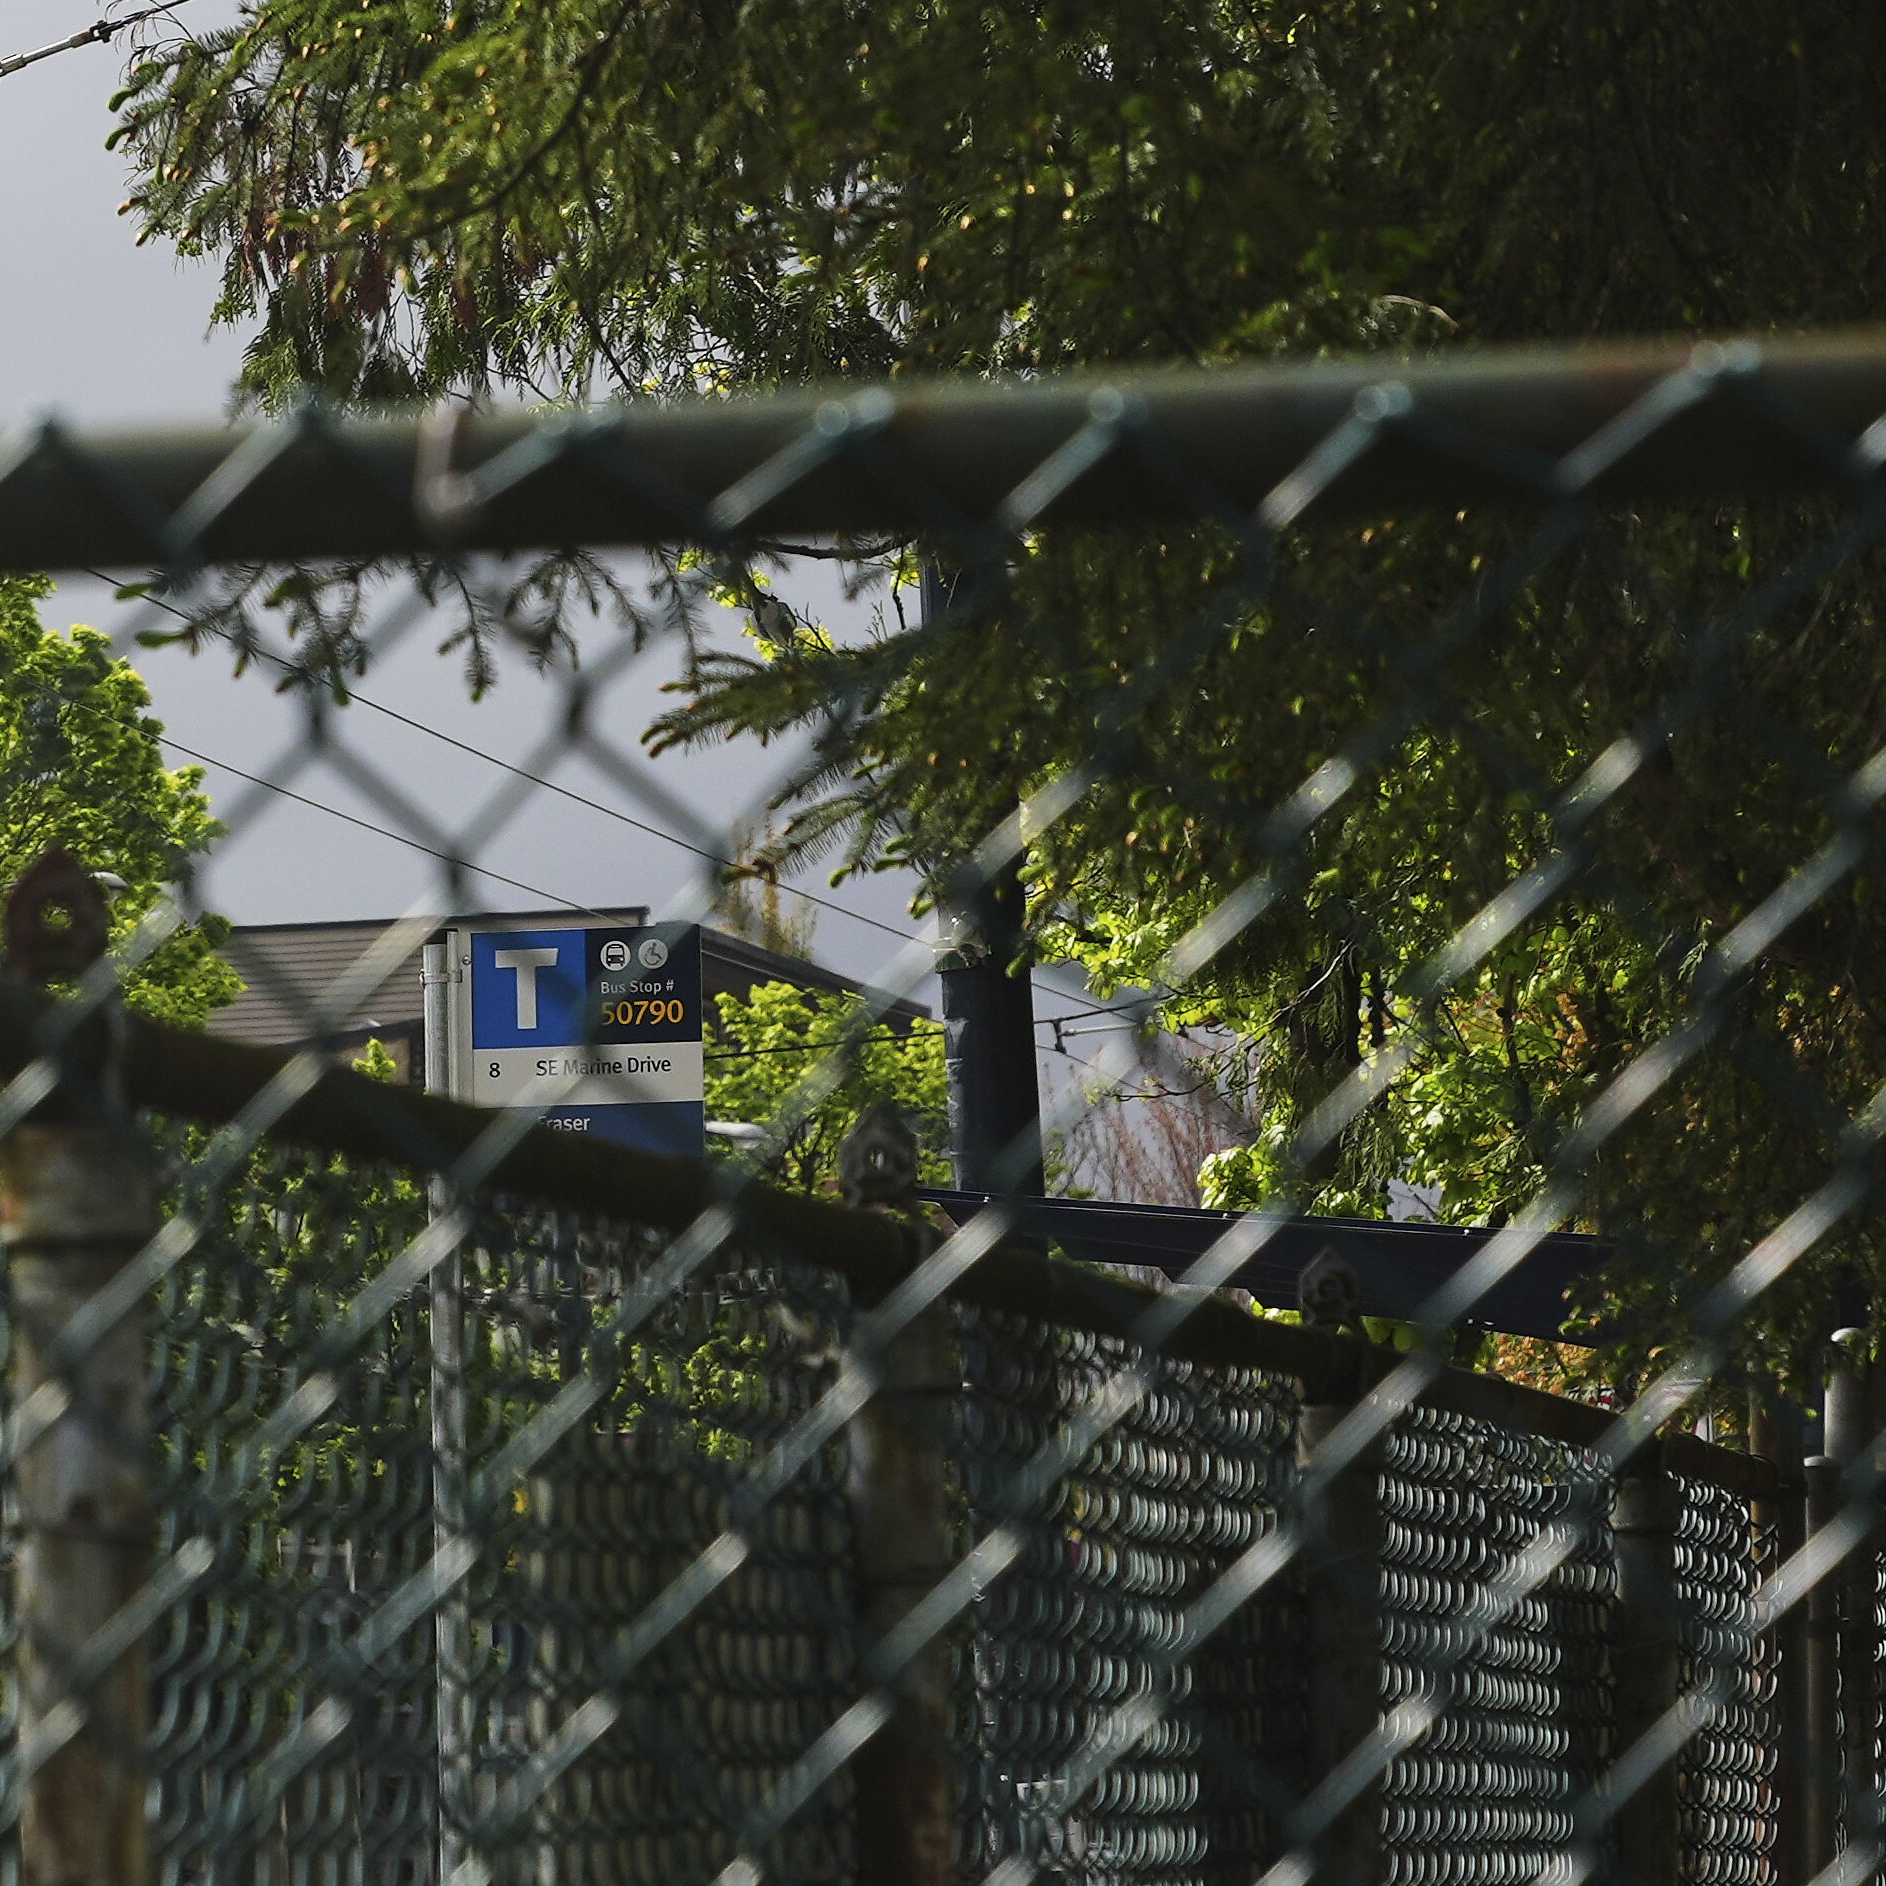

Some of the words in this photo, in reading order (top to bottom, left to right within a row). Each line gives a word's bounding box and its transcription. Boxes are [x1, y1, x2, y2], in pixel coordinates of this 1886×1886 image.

[495, 948, 559, 1030] T
[601, 981, 625, 994] Bus
[630, 979, 662, 996] Stop
[666, 979, 674, 991] #
[600, 999, 684, 1026] 50790
[489, 1062, 501, 1078] 8
[536, 1060, 558, 1076] SE
[564, 1059, 622, 1076] Marine
[628, 1056, 671, 1073] Drive
